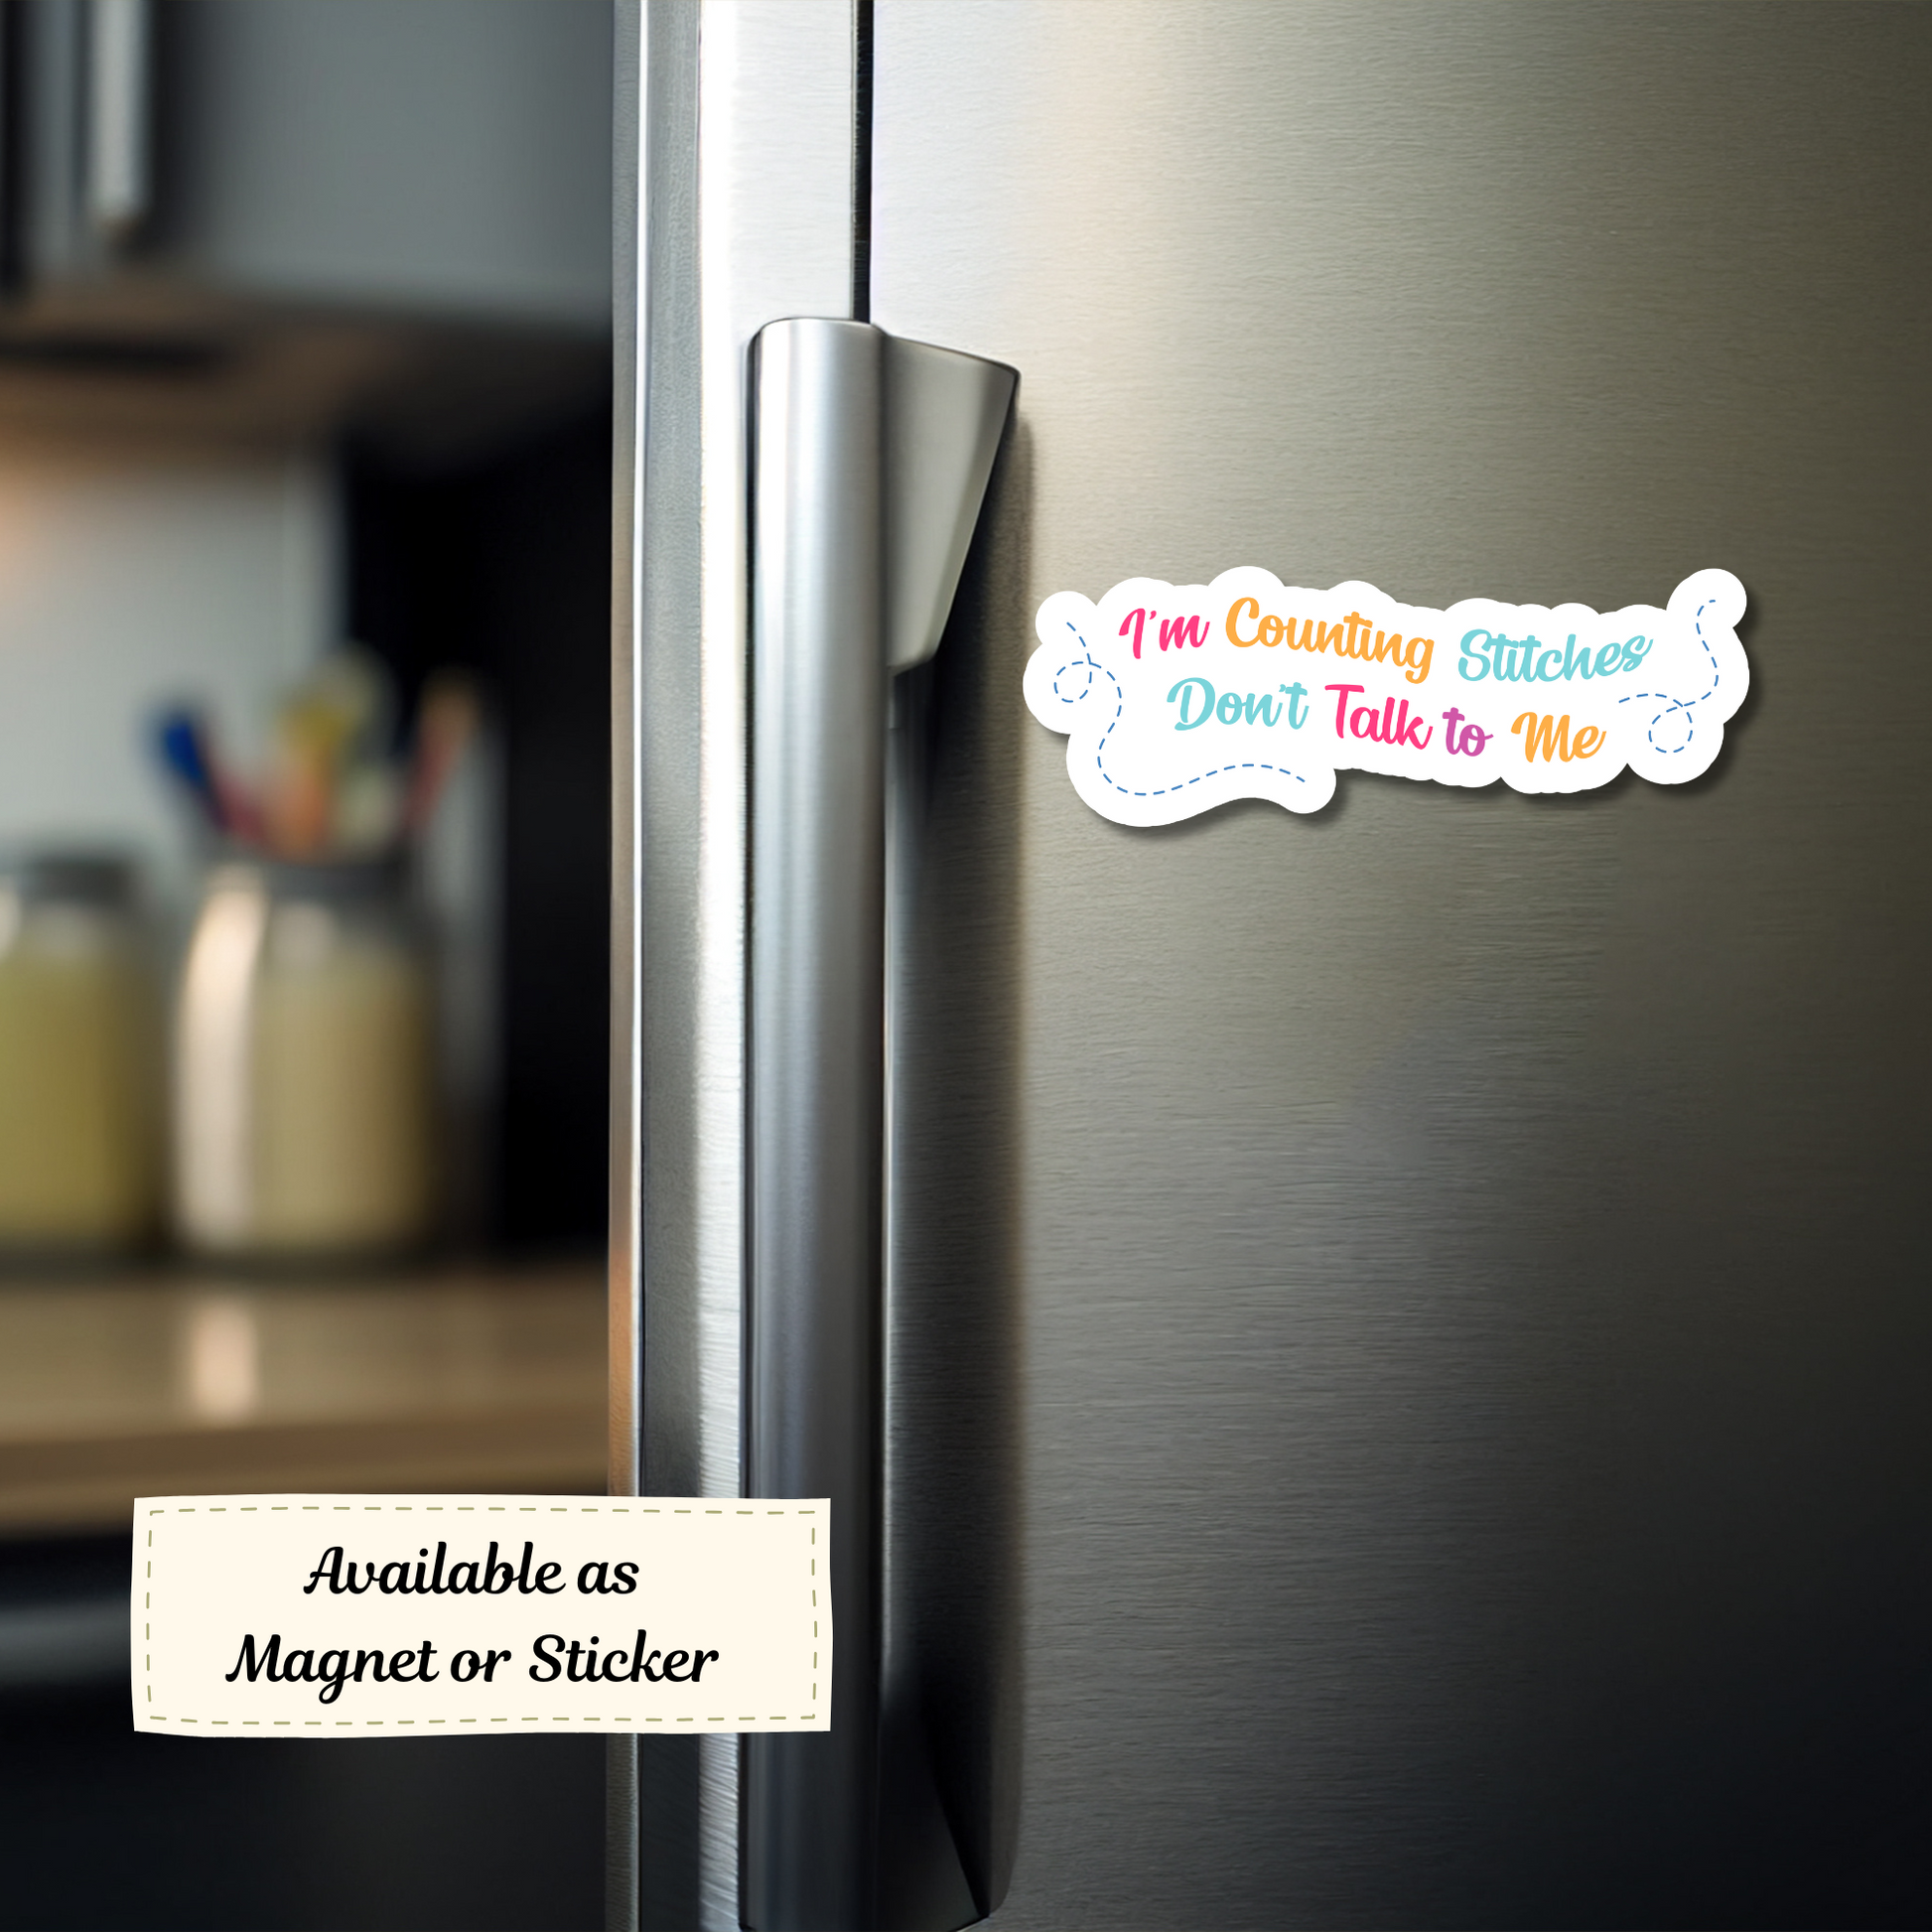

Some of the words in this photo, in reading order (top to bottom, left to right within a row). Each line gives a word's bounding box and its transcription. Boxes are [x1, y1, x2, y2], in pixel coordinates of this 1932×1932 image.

[1118, 608, 1211, 660] I'm
[1225, 596, 1436, 685] Counting
[1457, 628, 1654, 683] Stitches
[1167, 677, 1310, 732] Don't
[1323, 683, 1434, 751] Talk
[1442, 706, 1494, 758] to
[1510, 711, 1607, 763] Me
